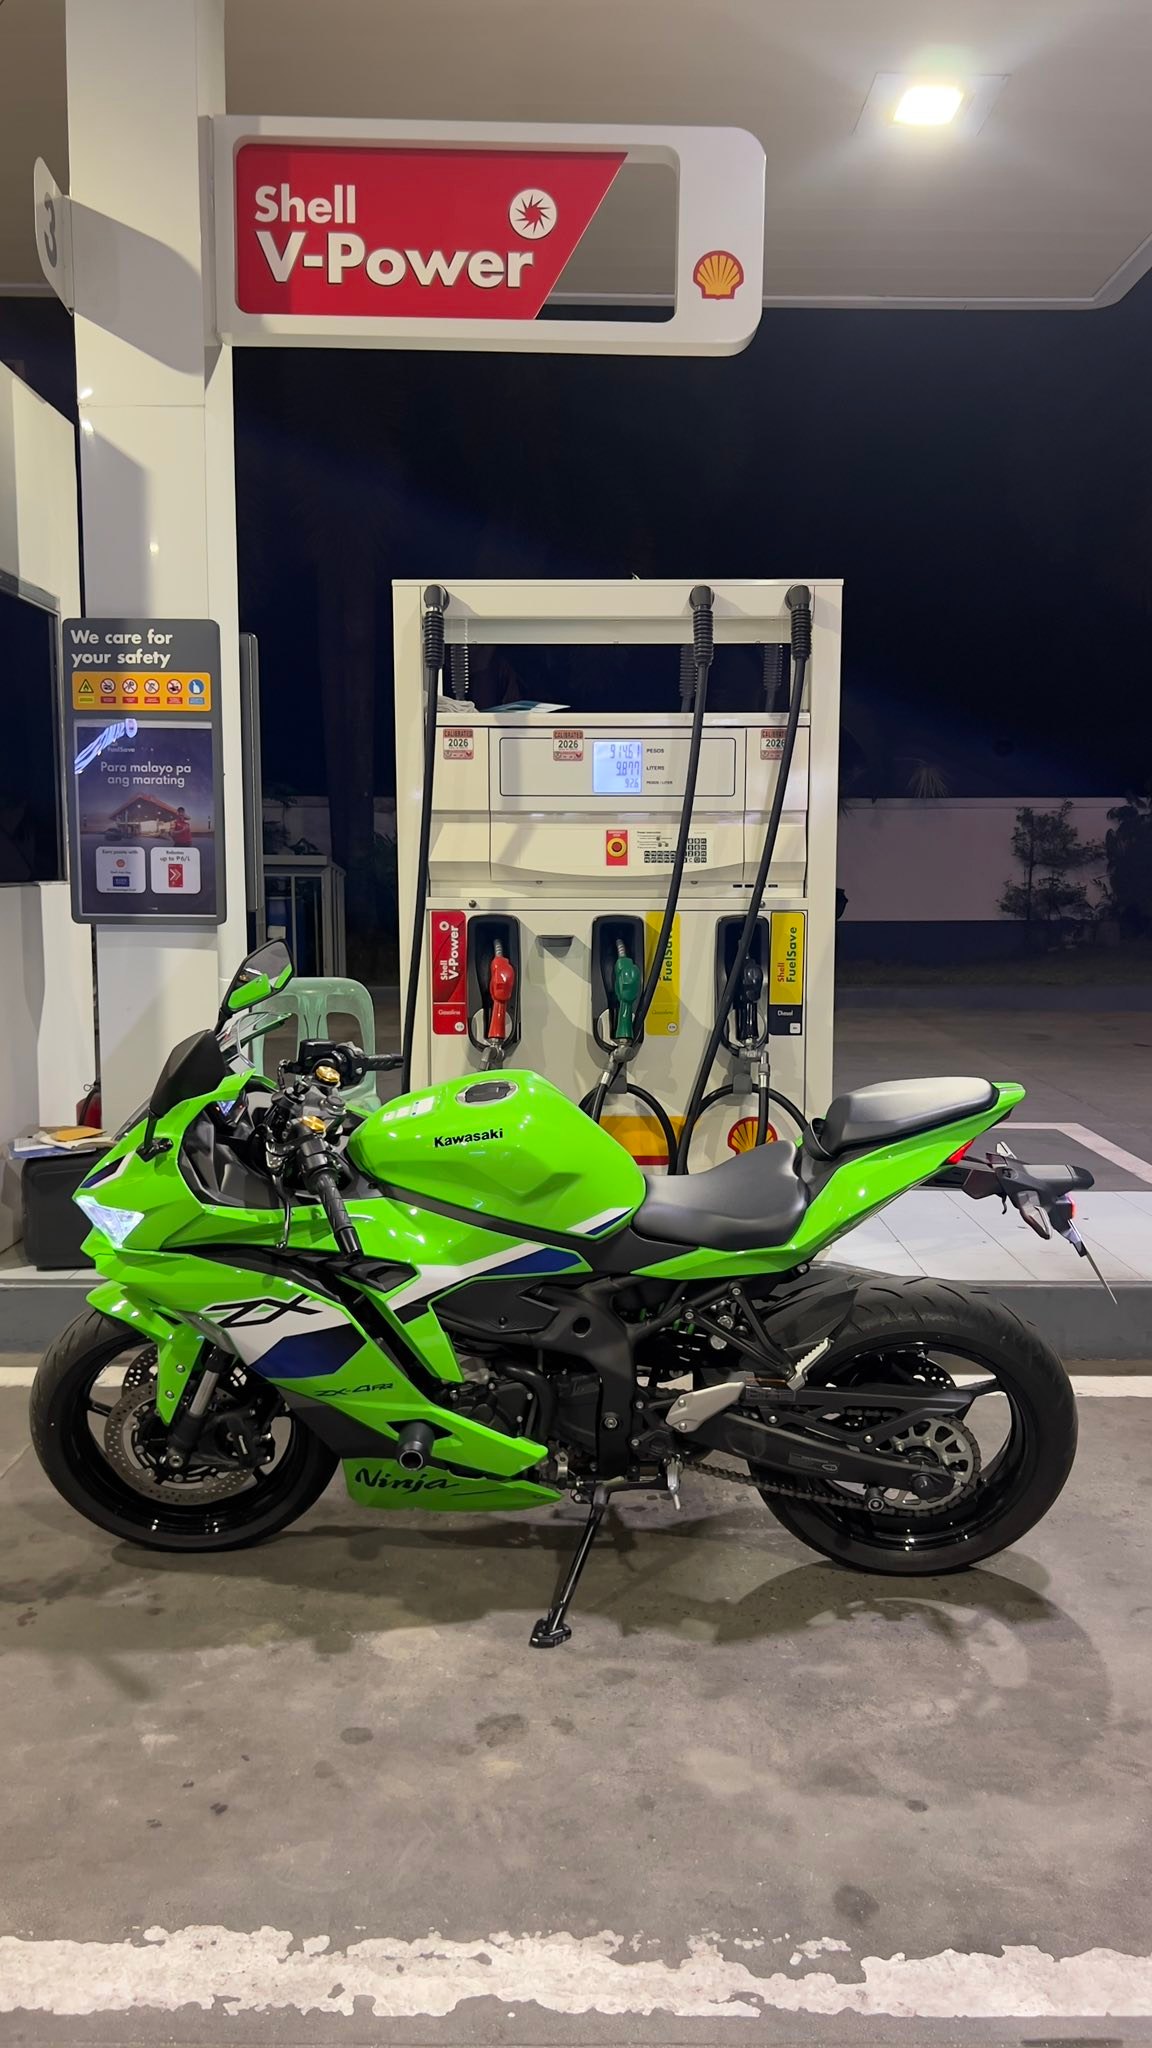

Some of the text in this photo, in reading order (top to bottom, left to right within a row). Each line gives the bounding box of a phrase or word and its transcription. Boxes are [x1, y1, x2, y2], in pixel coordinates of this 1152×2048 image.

[255, 184, 356, 224] Shell
[44, 192, 58, 268] 3
[256, 231, 534, 288] V-Power
[70, 629, 173, 644] We care for
[71, 648, 171, 668] your safety
[448, 738, 469, 747] 2026
[558, 740, 579, 748] 2026
[101, 761, 191, 776] Para malayo pa
[108, 774, 185, 788] ang marating
[448, 925, 459, 980] V-Power
[786, 927, 797, 982] FuelSave
[440, 960, 448, 980] Shell
[777, 962, 785, 982] Shell
[434, 1128, 503, 1148] Kawasaki
[204, 1293, 323, 1328] ZX
[355, 1468, 460, 1495] Ninja
